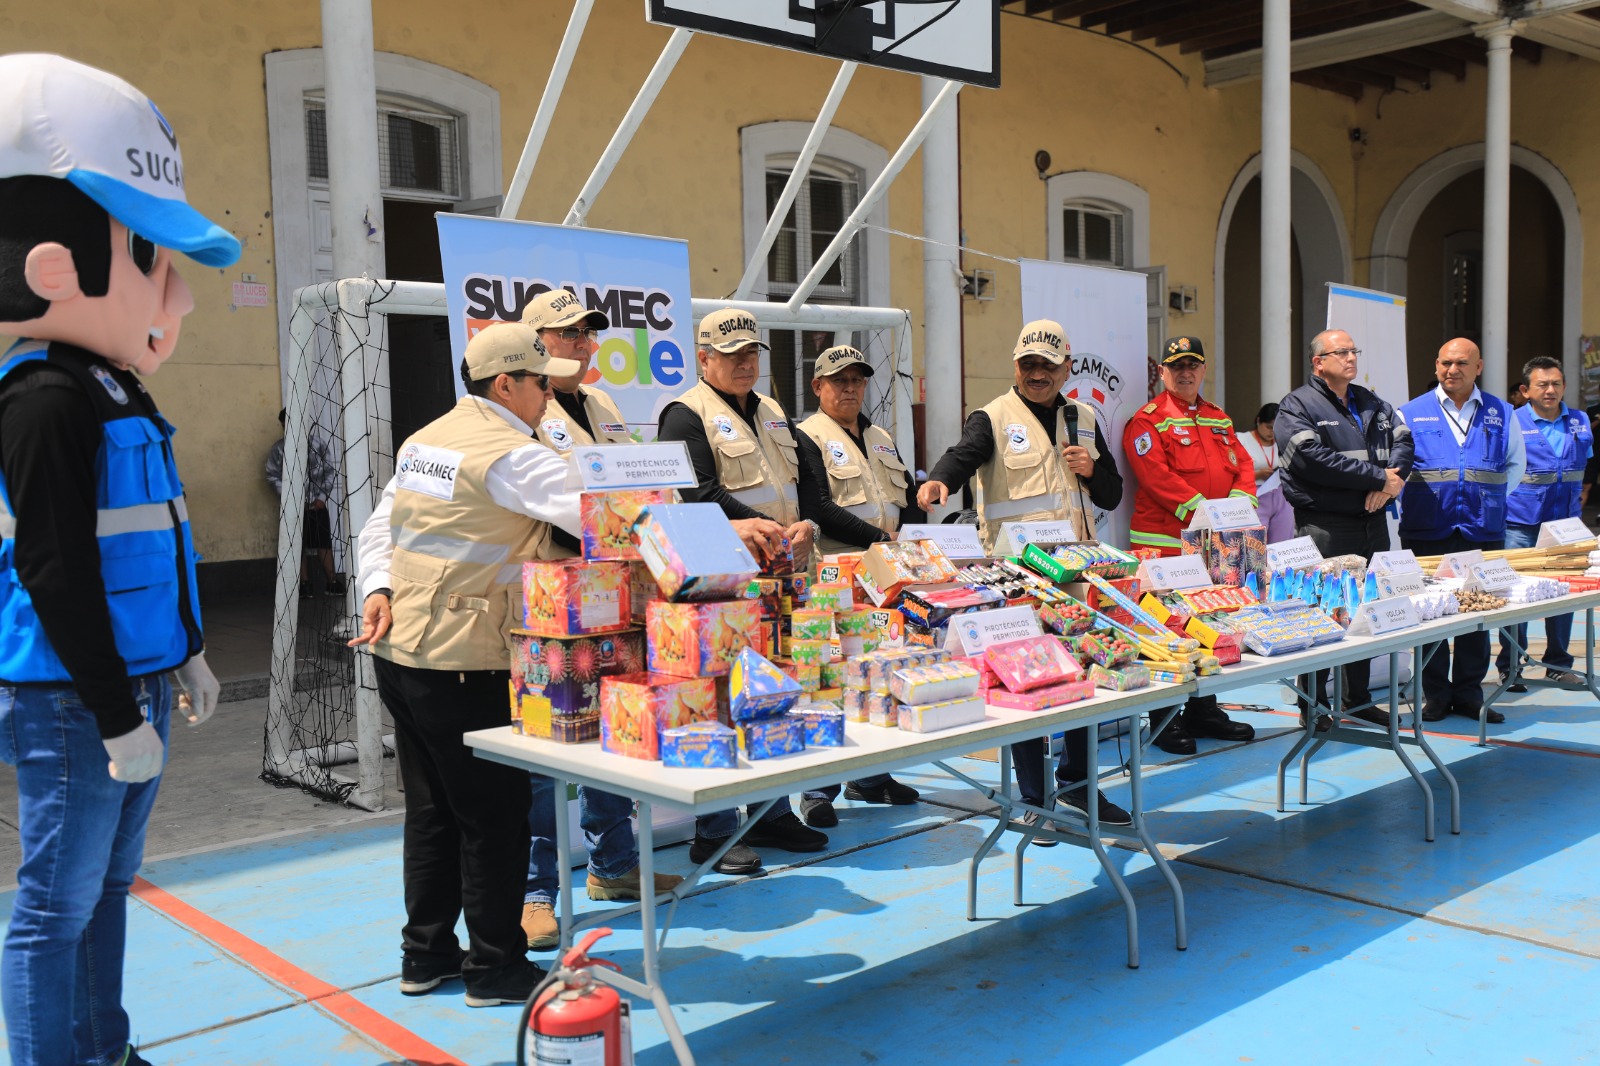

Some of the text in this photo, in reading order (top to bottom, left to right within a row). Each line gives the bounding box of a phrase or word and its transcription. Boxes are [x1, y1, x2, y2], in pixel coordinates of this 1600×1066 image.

[719, 317, 757, 336] SUCAMEC
[1022, 330, 1061, 349] SUCAMEC
[503, 353, 526, 363] PERU
[1070, 357, 1119, 391] CAMEC
[1484, 419, 1503, 427] LIMA
[616, 458, 680, 469] PIROTÉCNICOS
[411, 459, 455, 481] SUCAMEC
[625, 469, 678, 478] PERMITIDOS
[1035, 528, 1062, 536] FUENTE
[1028, 552, 1059, 576] FSS2019
[1170, 570, 1200, 578] PETARDOS
[1385, 608, 1406, 617] VOLCÁN
[984, 619, 1030, 632] PIROTÉCNICOS
[993, 629, 1030, 641] PERMITIDOS
[582, 682, 598, 698] 36
